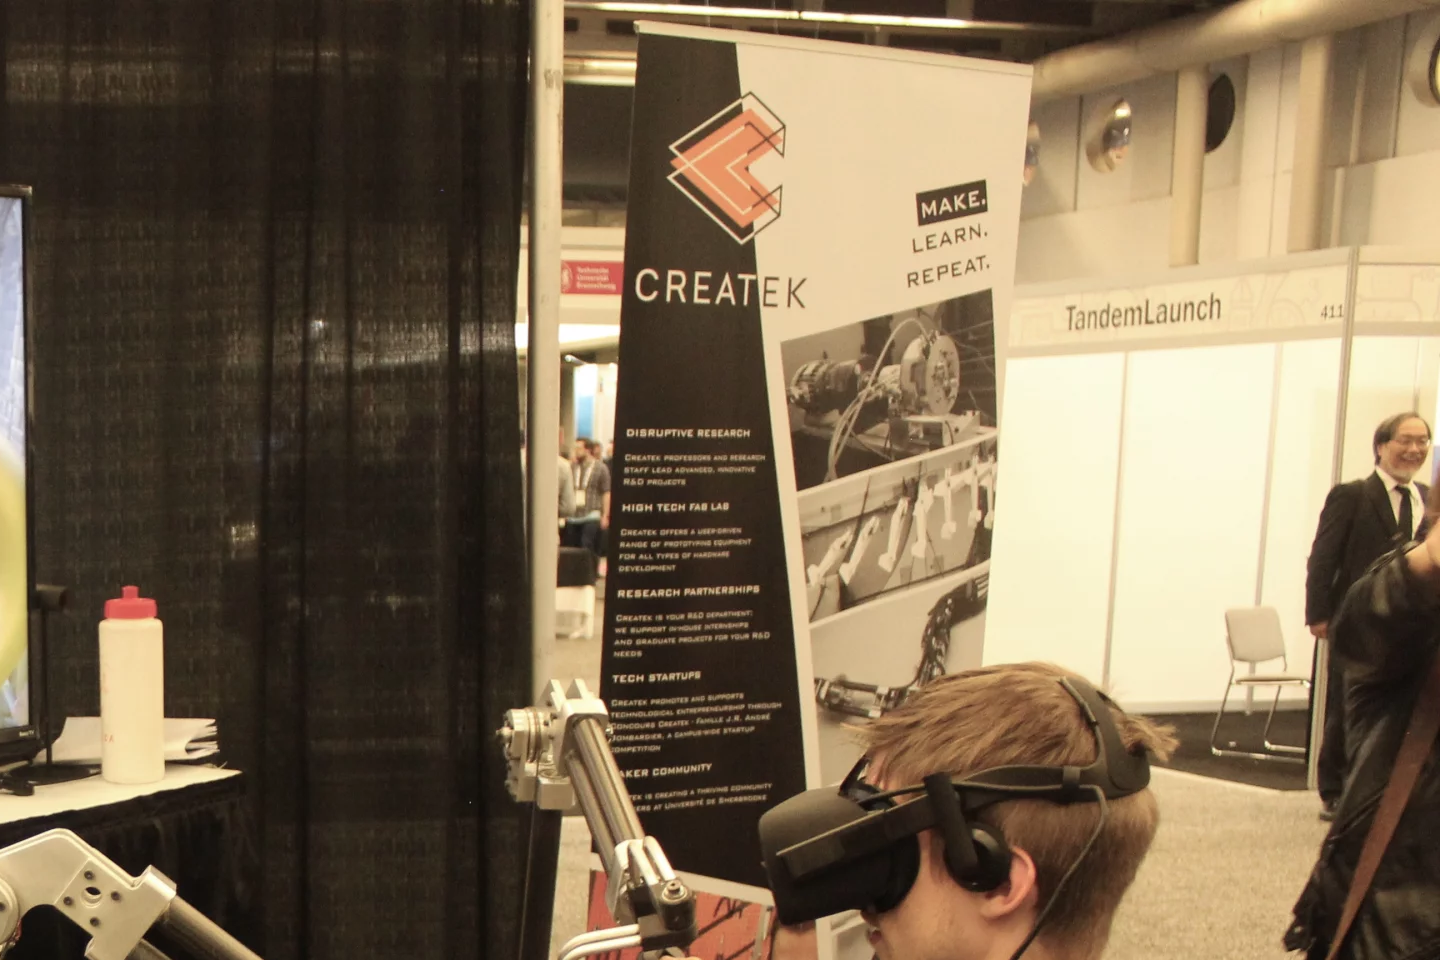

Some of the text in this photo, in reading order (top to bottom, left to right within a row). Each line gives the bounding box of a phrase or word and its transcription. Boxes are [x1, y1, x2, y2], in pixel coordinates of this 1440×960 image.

[921, 190, 986, 219] MAKE.
[912, 225, 988, 254] LEARN.
[907, 255, 990, 288] REPEAT.
[635, 267, 807, 309] CREATEK
[1066, 293, 1221, 331] TandemLaunch
[1321, 304, 1343, 320] 411
[627, 429, 750, 438] DISRUPTIVE RESEARCH
[622, 502, 729, 512] HIGH TECH FAB LAB
[618, 585, 760, 598] RESEARCH PARTNERSHIPS
[705, 622, 748, 631] INTERNSHIPS
[612, 671, 701, 683] TECH STARTUPS
[650, 697, 688, 705] PROMOTES
[708, 693, 744, 701] SUPPORTS
[611, 710, 674, 718] TECHNOLOGICAL
[723, 726, 755, 735] STARTUP
[620, 763, 712, 778] AKER COMMUNITY
[655, 790, 687, 799] CREATING
[731, 783, 772, 792] COMMUNITY
[719, 794, 766, 804] SHERBROOKE
